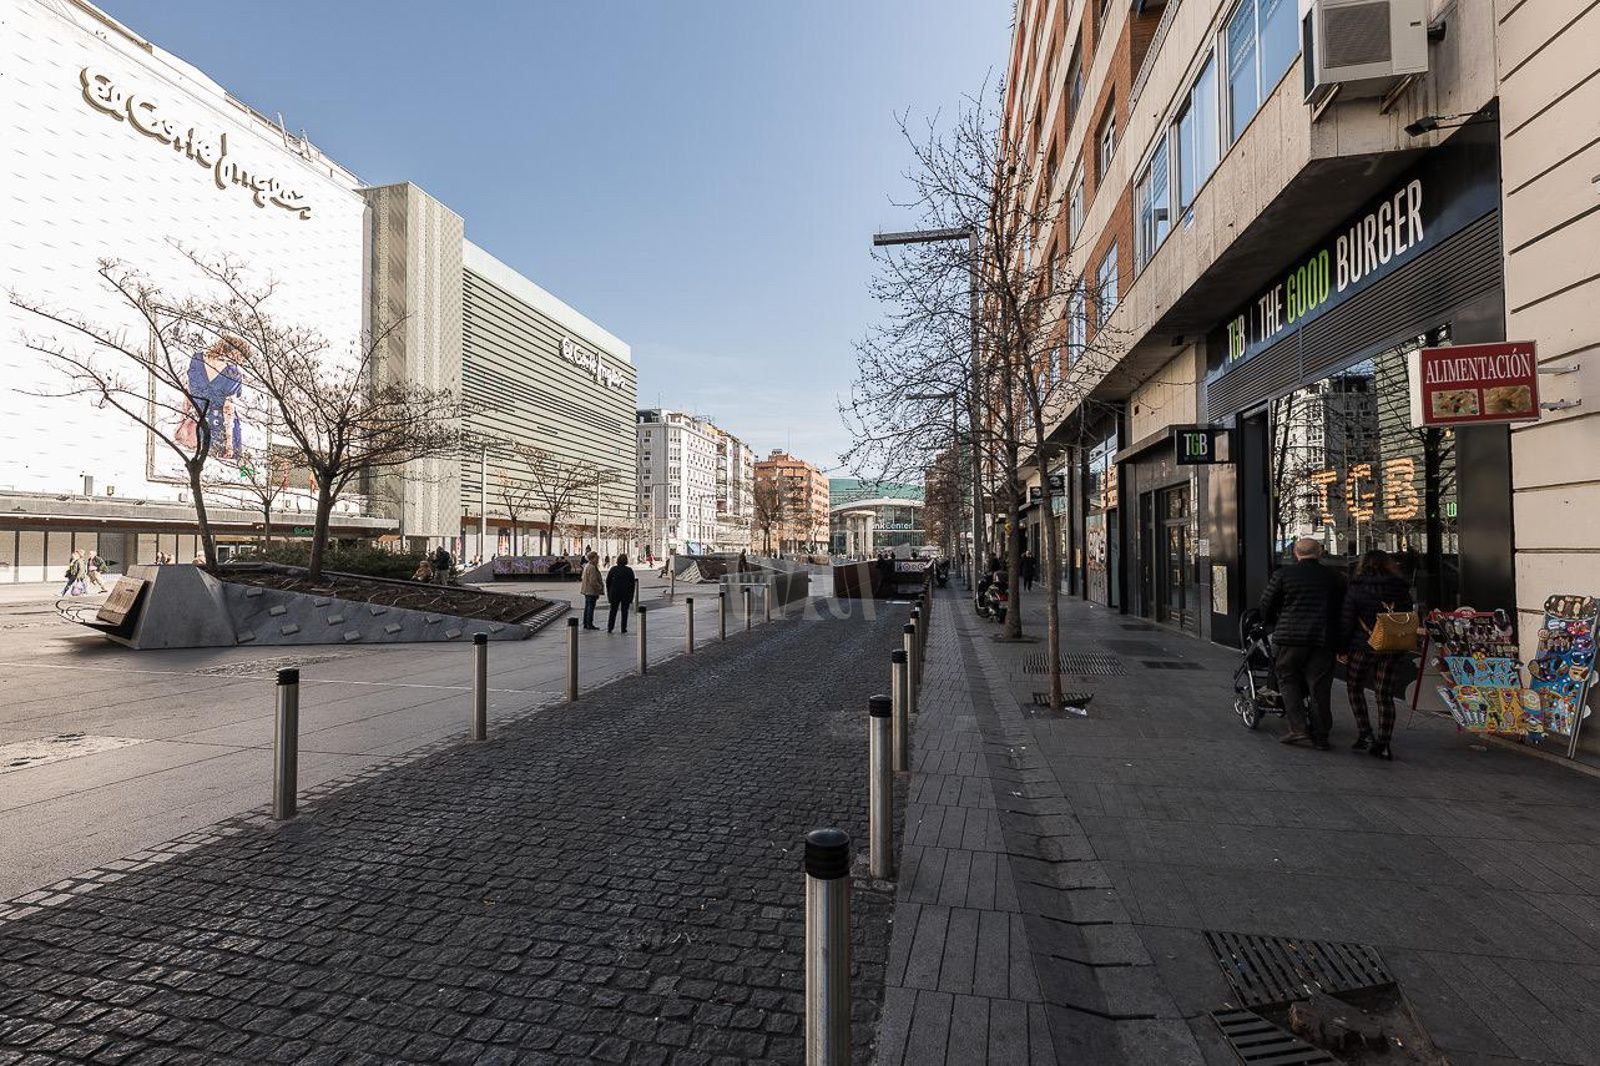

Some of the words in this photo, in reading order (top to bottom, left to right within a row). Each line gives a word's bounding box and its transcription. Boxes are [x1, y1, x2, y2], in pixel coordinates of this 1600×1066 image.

[1227, 314, 1246, 363] TGB
[1258, 284, 1283, 342] THE
[1286, 249, 1329, 324] GOOD
[1336, 179, 1424, 293] BURGER
[1426, 348, 1531, 383] ALIMENTACIÓN
[1183, 433, 1208, 456] TGB
[1311, 457, 1419, 525] TGB
